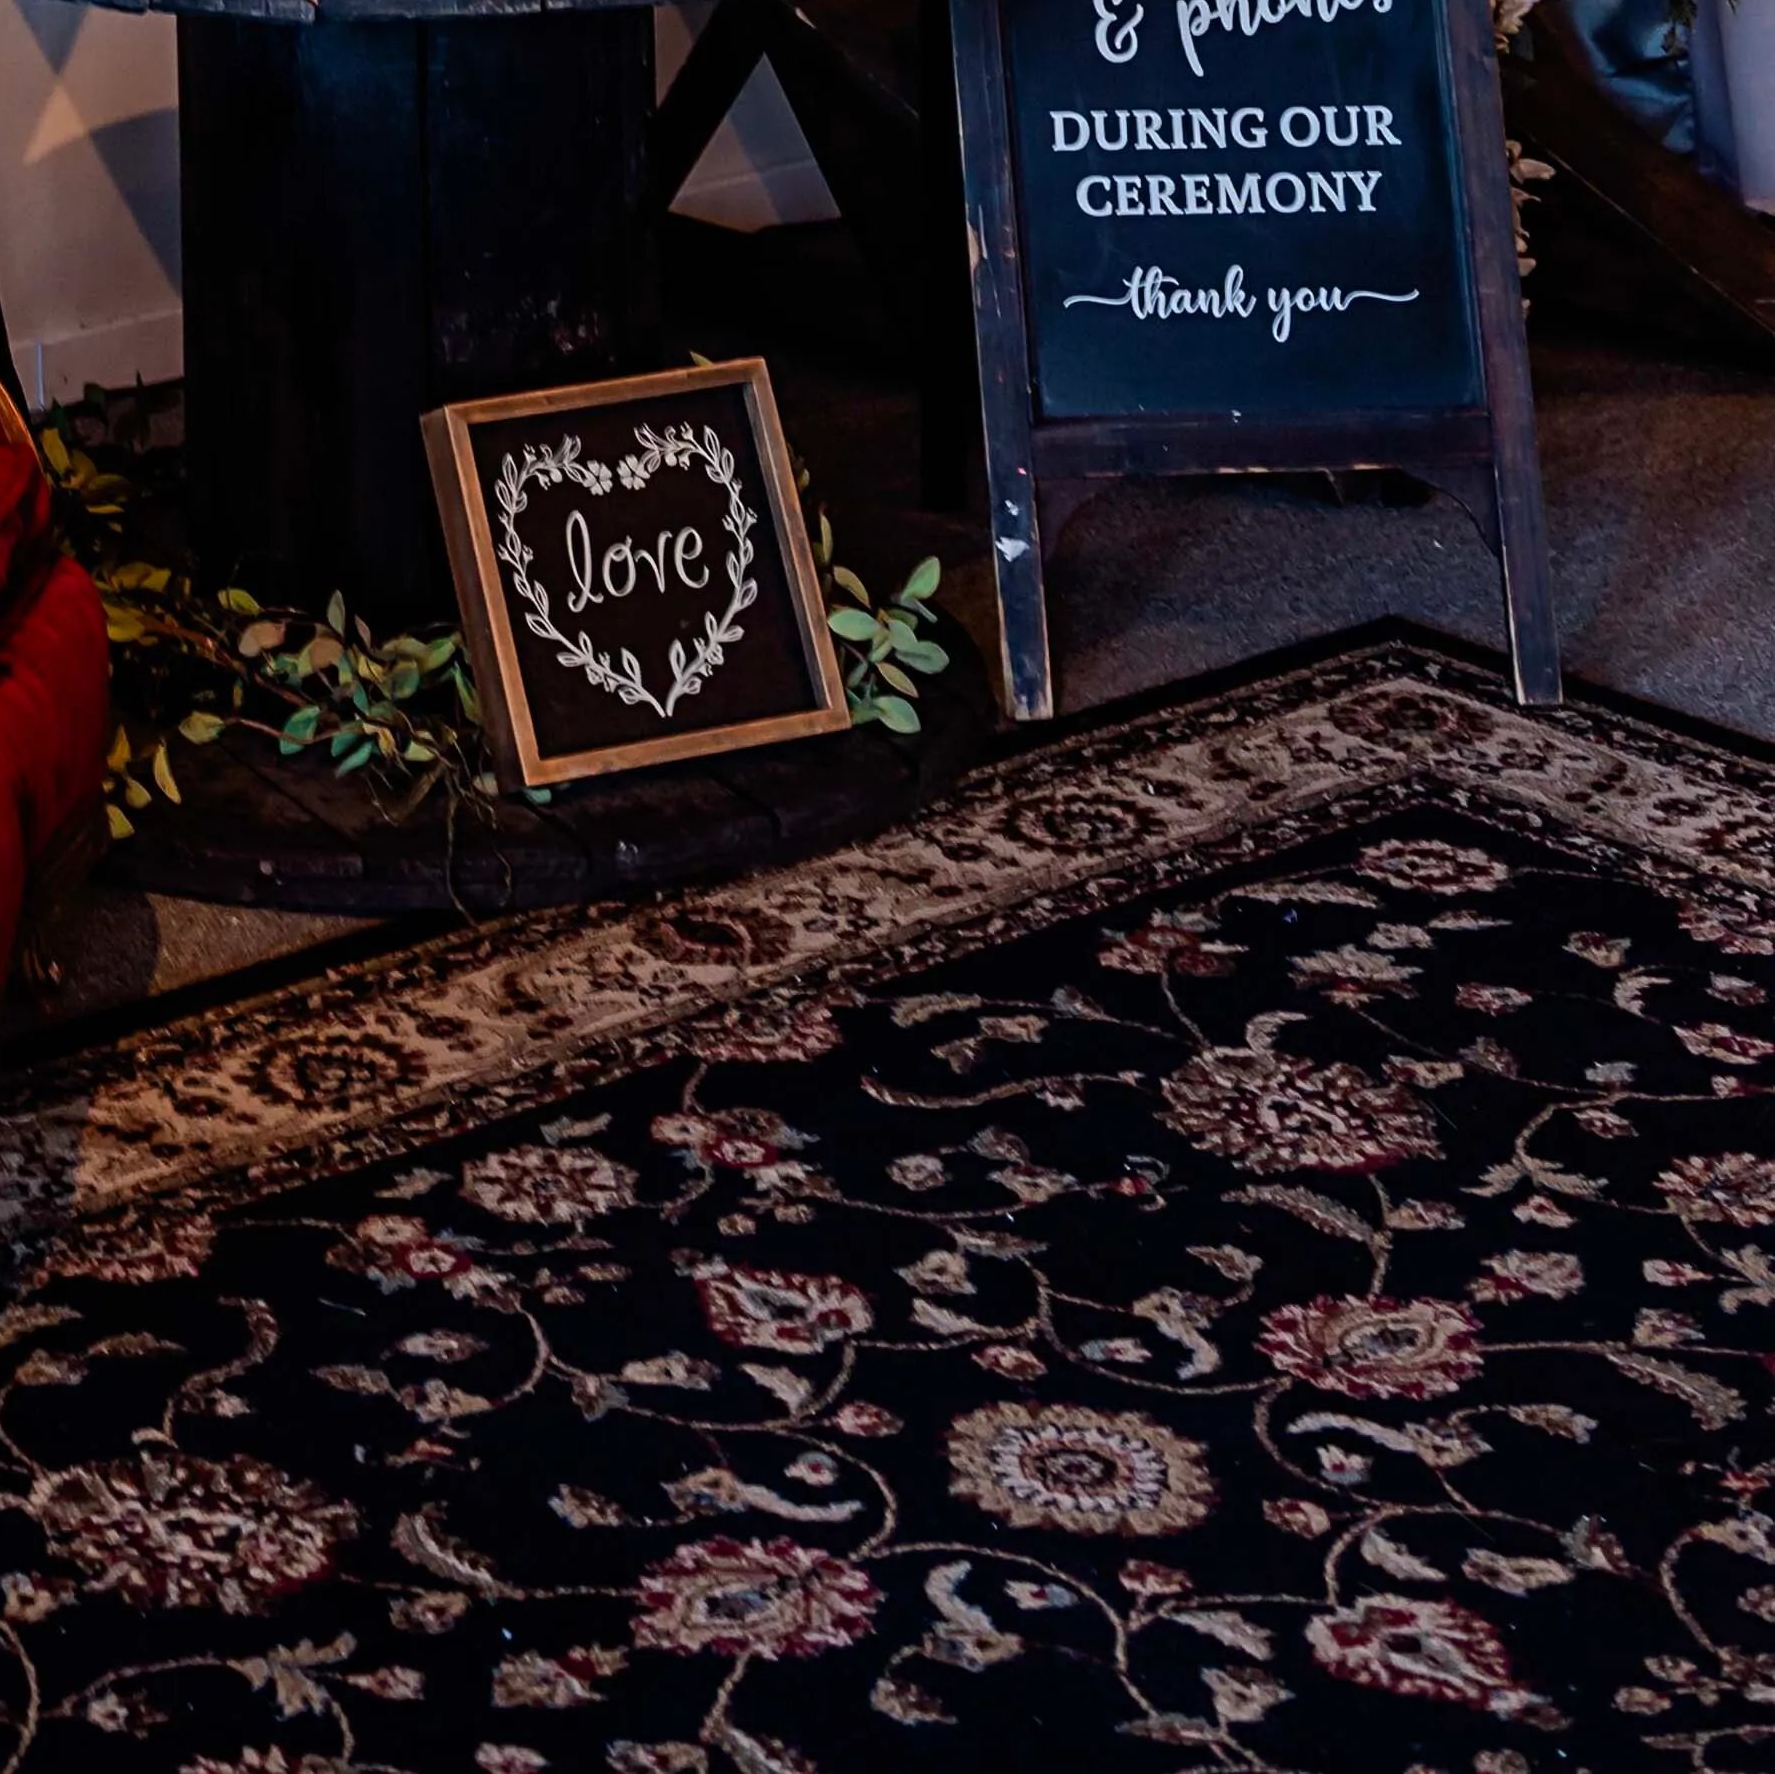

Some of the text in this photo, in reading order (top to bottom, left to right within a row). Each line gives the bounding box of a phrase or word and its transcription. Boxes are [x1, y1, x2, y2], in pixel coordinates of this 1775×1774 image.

[1049, 105, 1402, 152] DURING OUR
[1075, 170, 1383, 217] CEREMONY
[1062, 264, 1420, 343] thank you
[565, 509, 710, 613] love
